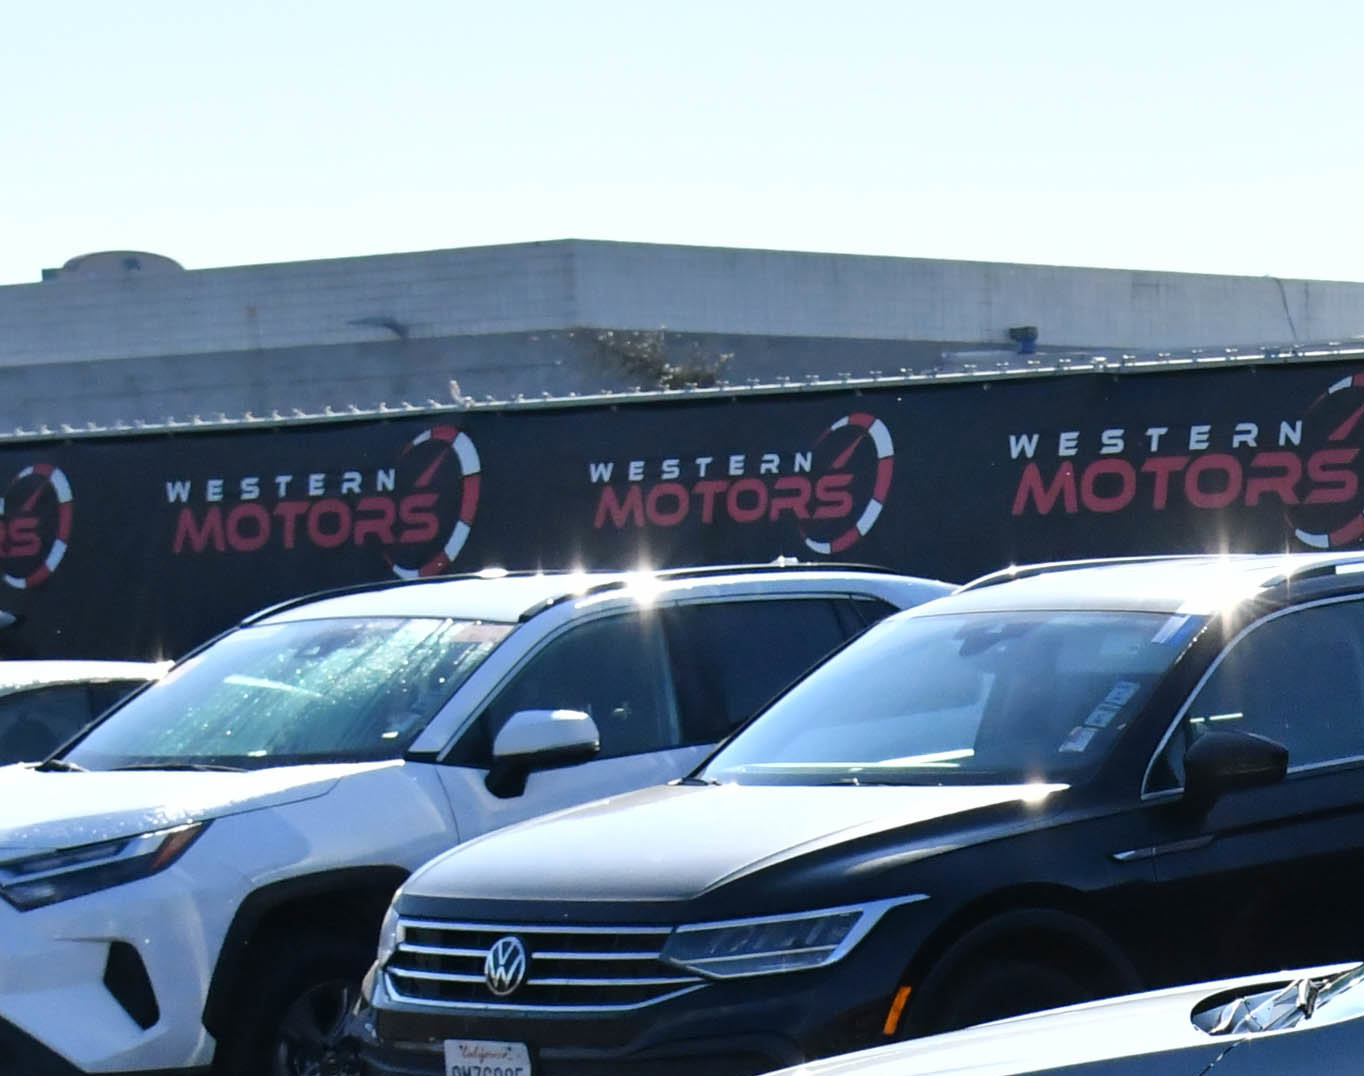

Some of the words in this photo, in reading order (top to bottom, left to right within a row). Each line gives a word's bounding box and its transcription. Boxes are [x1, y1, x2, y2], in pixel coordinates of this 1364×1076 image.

[1009, 420, 1303, 460] WESTERN
[166, 469, 396, 504] WESTERN
[589, 451, 813, 485] WESTERN
[1010, 449, 1361, 516] MOTORS
[171, 493, 441, 553] MOTORS
[593, 474, 856, 529] MOTORS
